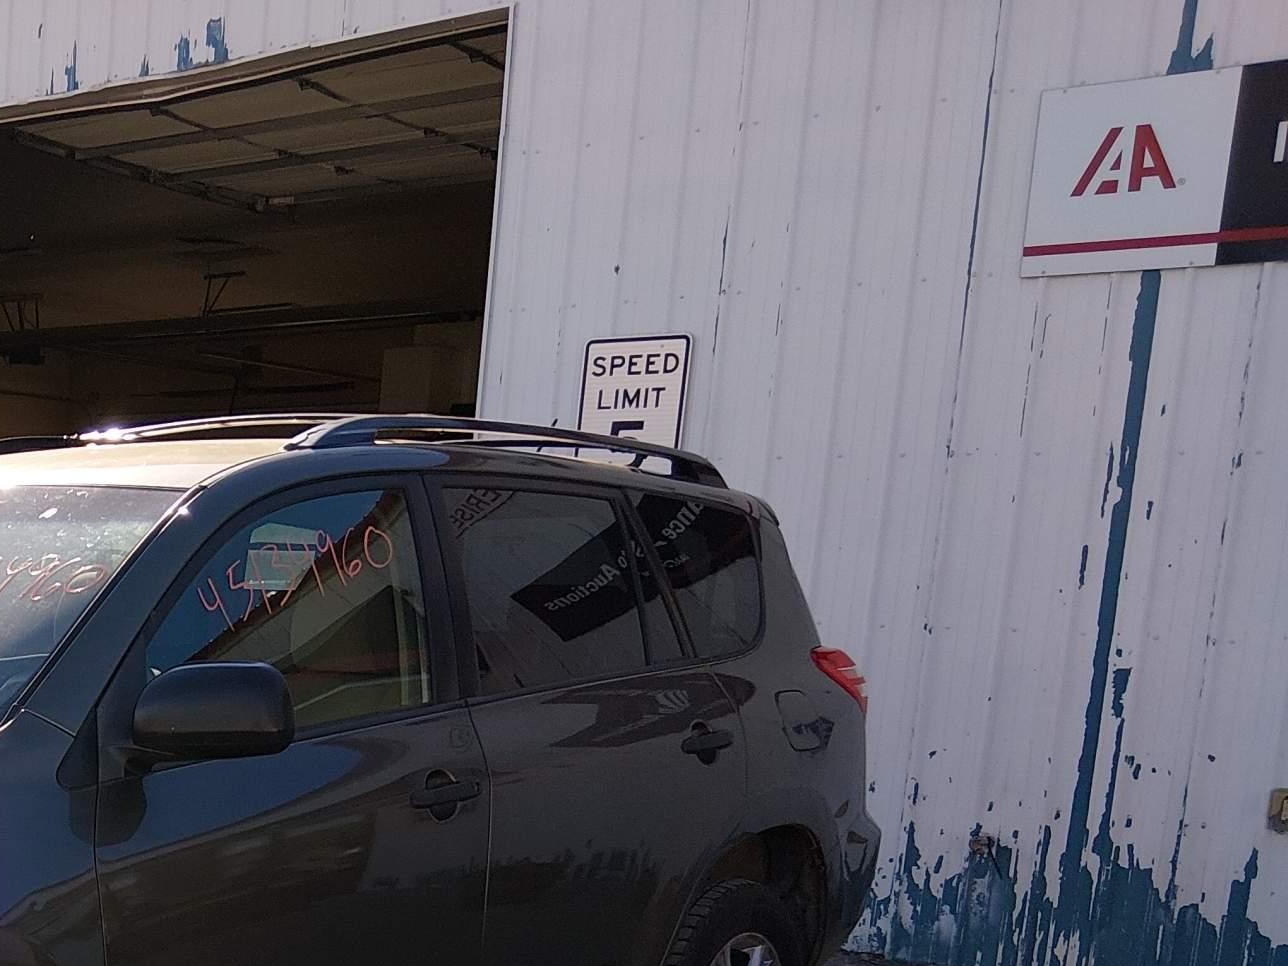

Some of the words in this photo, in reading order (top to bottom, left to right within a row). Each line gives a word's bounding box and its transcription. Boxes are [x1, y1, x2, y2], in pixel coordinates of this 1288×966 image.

[592, 353, 680, 377] SPEED
[597, 387, 666, 410] LIMIT
[197, 526, 393, 632] 45134960
